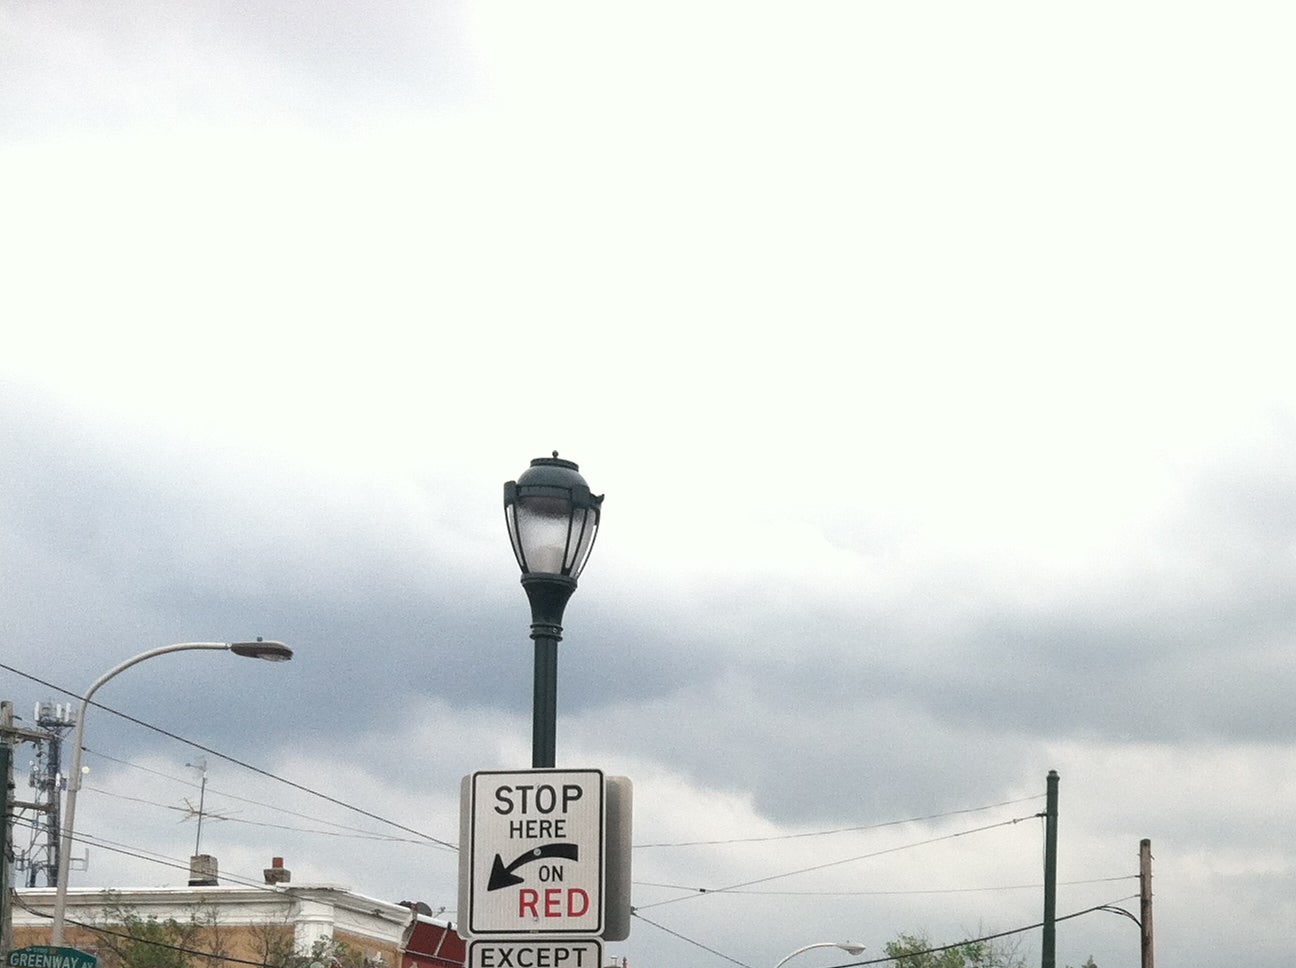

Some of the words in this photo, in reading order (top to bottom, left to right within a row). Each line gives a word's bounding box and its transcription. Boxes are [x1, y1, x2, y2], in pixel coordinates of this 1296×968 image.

[494, 784, 583, 815] STOP
[509, 820, 566, 839] HERE
[538, 865, 563, 882] ON
[519, 888, 590, 917] RED
[481, 948, 587, 968] EXCEPT
